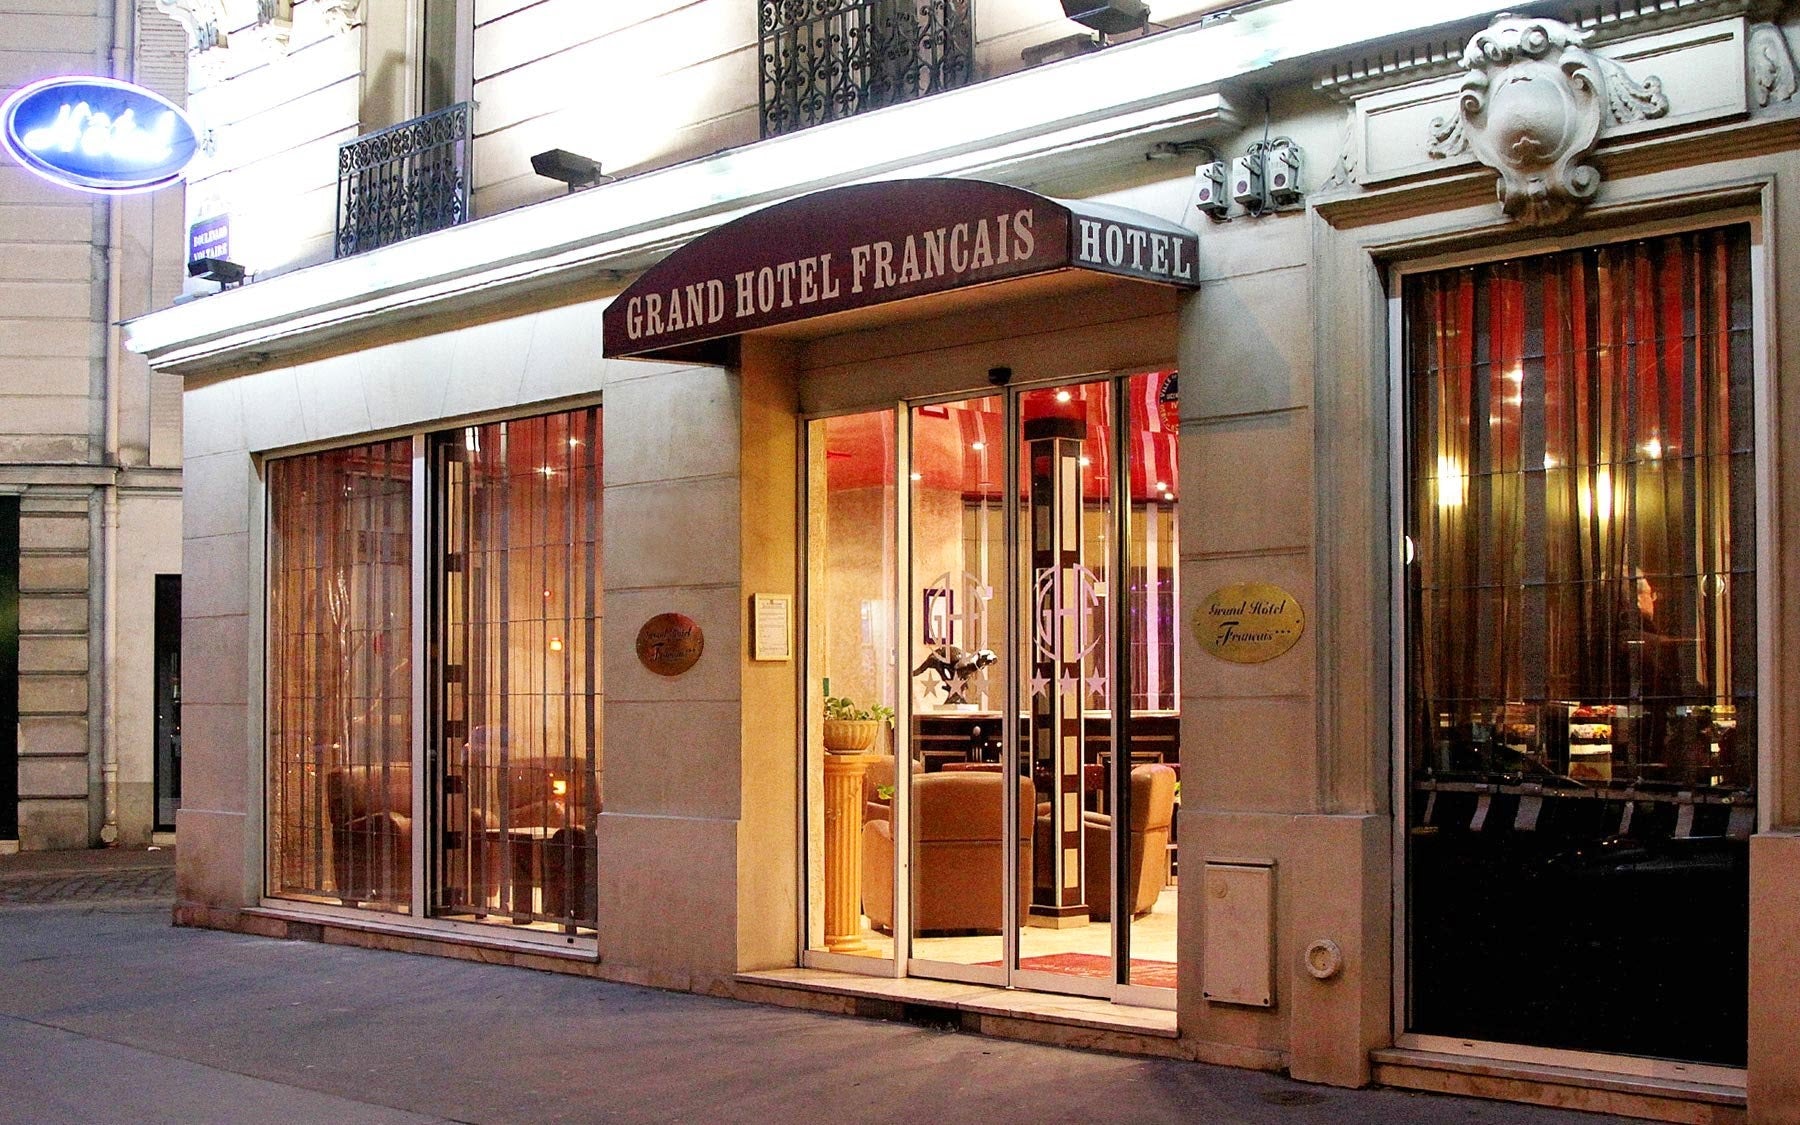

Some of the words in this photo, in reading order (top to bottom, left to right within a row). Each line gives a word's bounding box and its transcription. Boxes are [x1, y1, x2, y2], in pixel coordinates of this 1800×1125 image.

[626, 279, 725, 341] GRAND
[735, 252, 840, 319] HOTEL
[851, 208, 1036, 294] FRANCAIS
[1078, 218, 1192, 280] HOTEL
[1208, 600, 1247, 616] Grand
